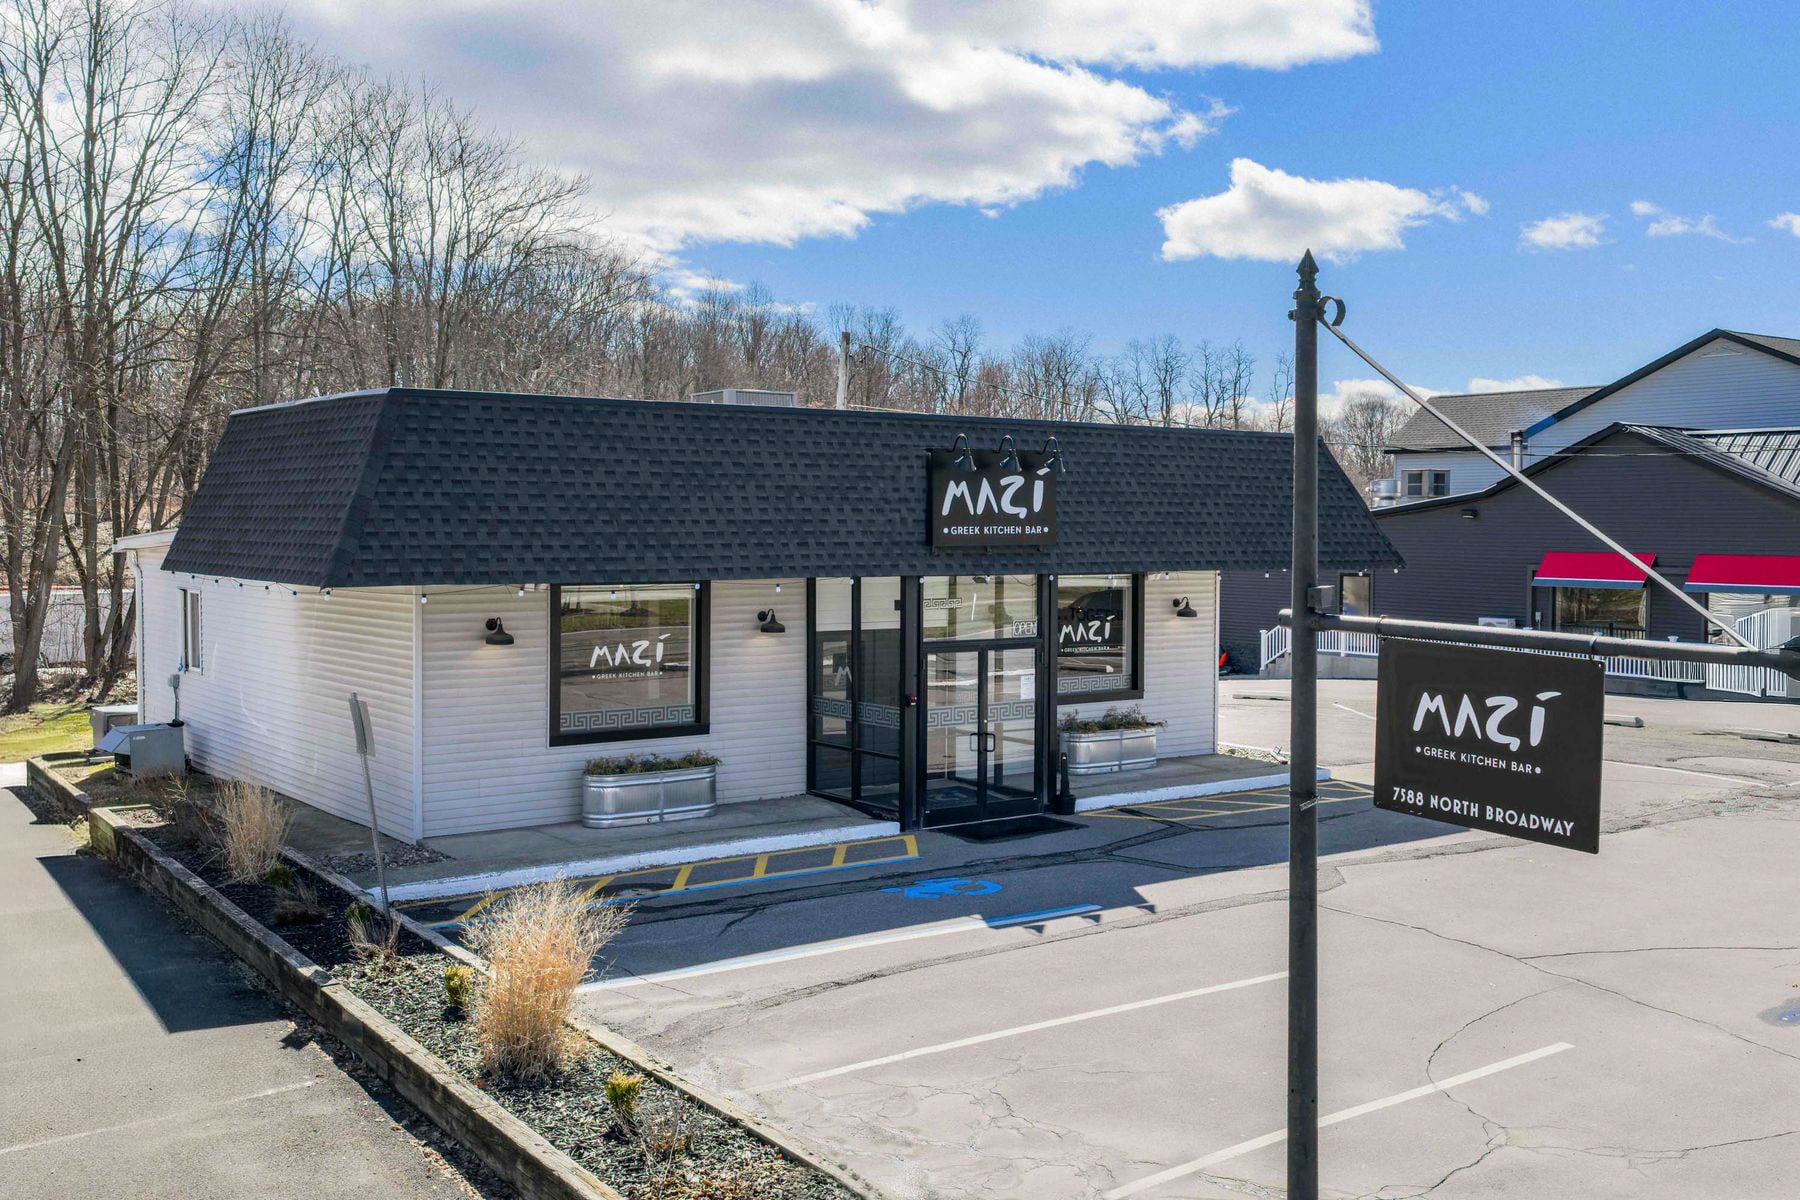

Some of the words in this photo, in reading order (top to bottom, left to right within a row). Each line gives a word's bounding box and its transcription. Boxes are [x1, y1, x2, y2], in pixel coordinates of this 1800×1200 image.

[950, 525, 980, 535] GREEK
[983, 525, 1022, 535] KITCHEN
[1025, 525, 1042, 534] BAR
[596, 672, 617, 680] GREEK
[618, 671, 645, 679] KITCHEN
[1423, 746, 1456, 761] GREEK
[1460, 752, 1506, 769] KITCHEN
[1511, 762, 1533, 774] BAR
[1392, 787, 1424, 806] 7588
[1429, 794, 1479, 818] NORTH
[1485, 805, 1575, 837] BROADWAY
